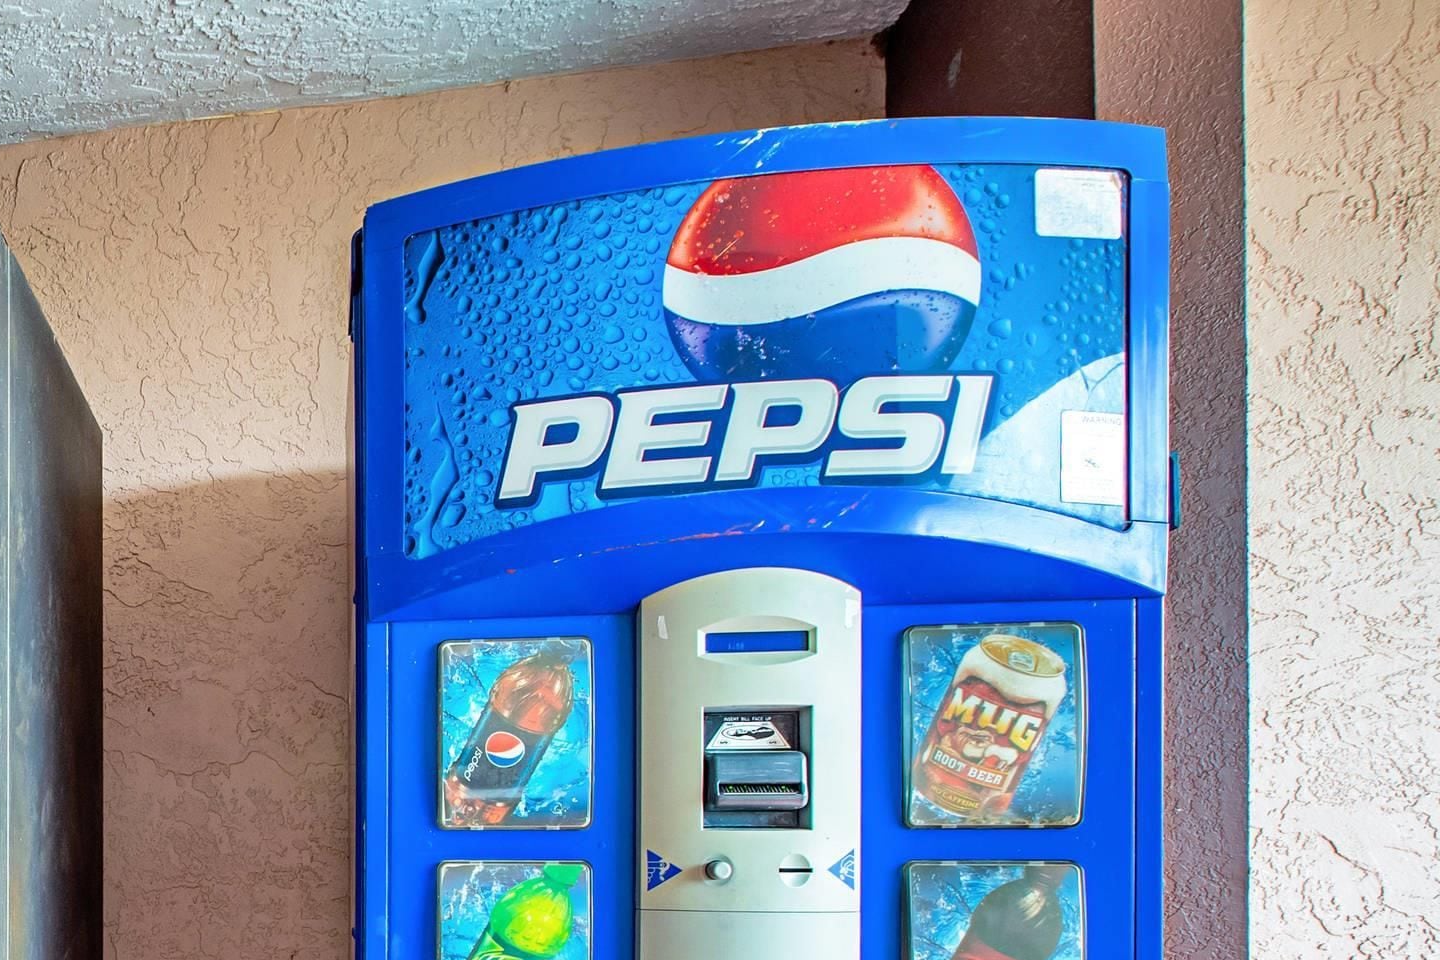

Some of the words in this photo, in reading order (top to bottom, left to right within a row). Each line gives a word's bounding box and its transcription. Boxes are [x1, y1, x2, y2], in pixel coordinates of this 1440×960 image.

[497, 372, 994, 503] PEPSI
[943, 687, 1044, 752] MUG
[463, 746, 484, 782] pepsi
[933, 749, 968, 773] ROOT
[966, 765, 1004, 786] BEER
